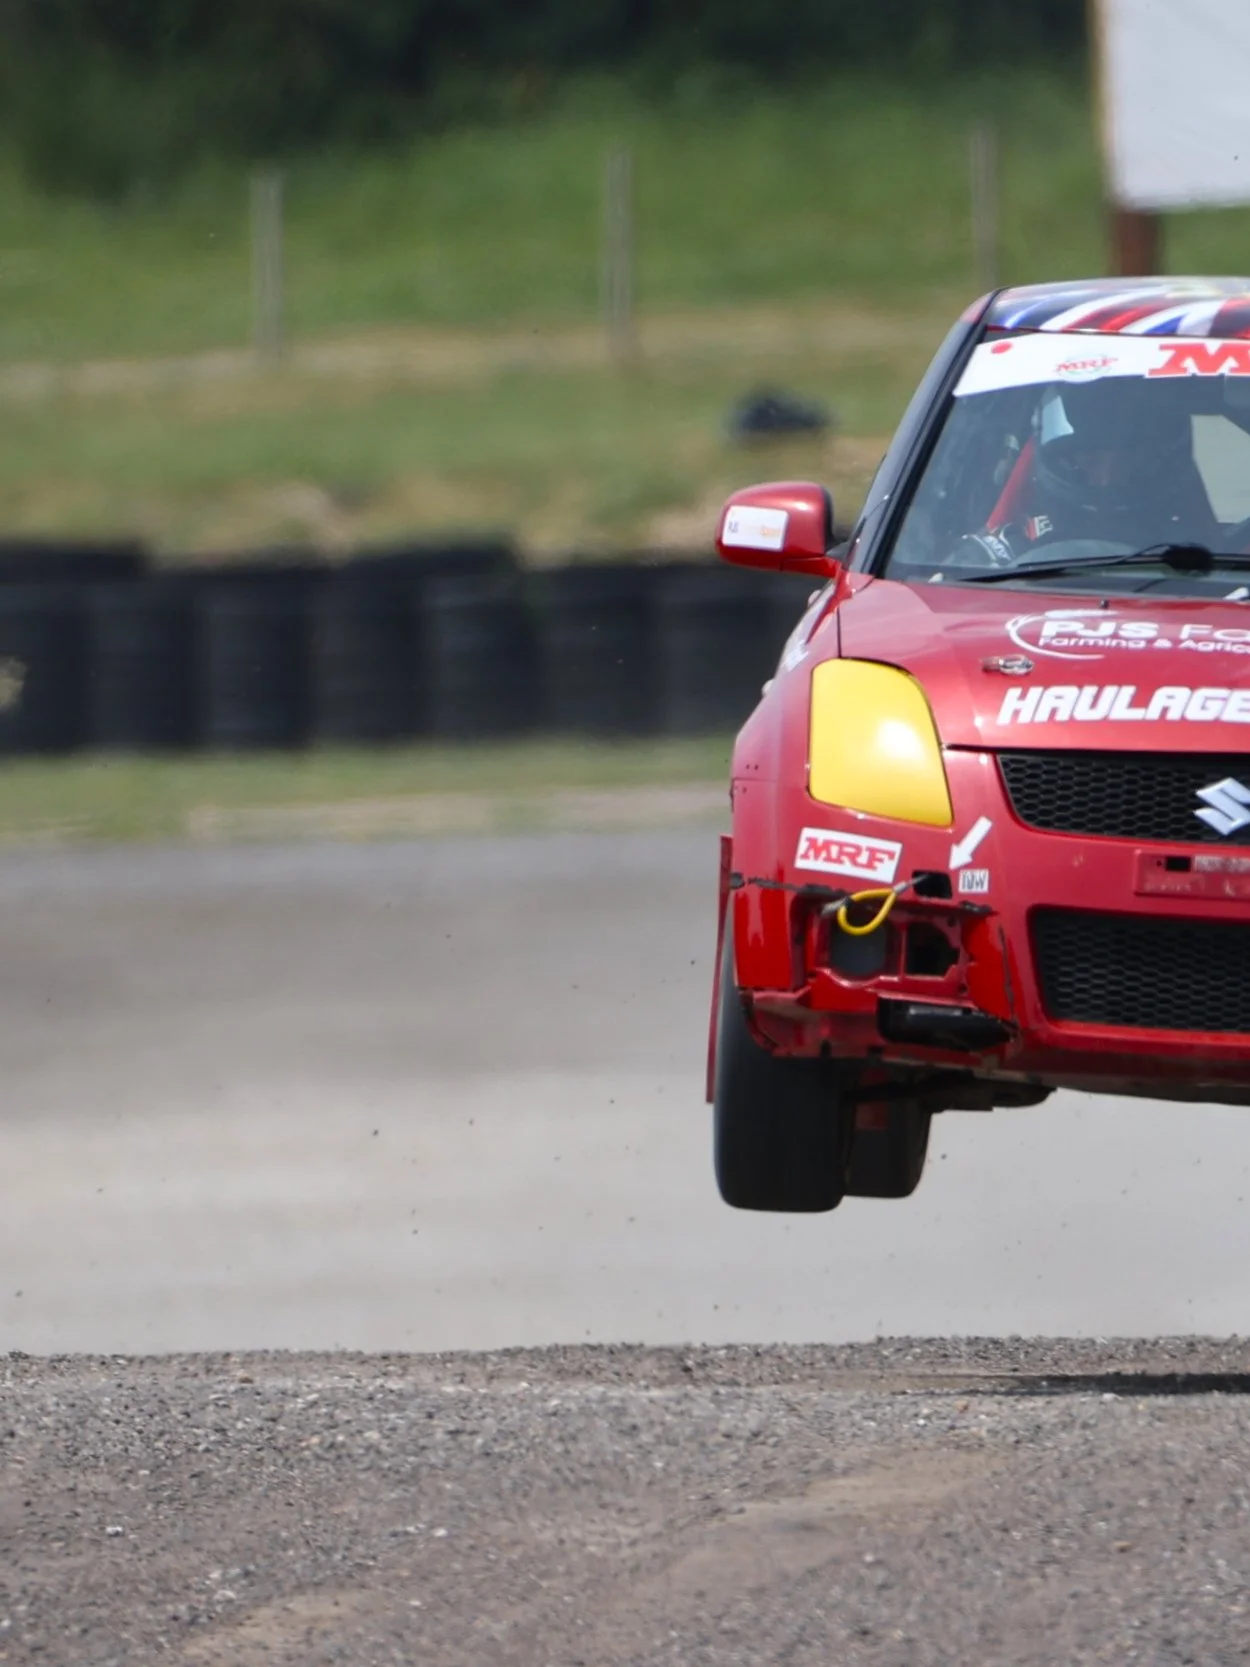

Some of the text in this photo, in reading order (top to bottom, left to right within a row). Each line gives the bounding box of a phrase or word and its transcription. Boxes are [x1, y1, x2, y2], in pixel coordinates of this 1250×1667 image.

[1055, 356, 1118, 373] MRF
[1040, 620, 1160, 639] PJS
[1037, 636, 1147, 649] Farming
[1153, 638, 1173, 649] &
[800, 834, 897, 872] MRF
